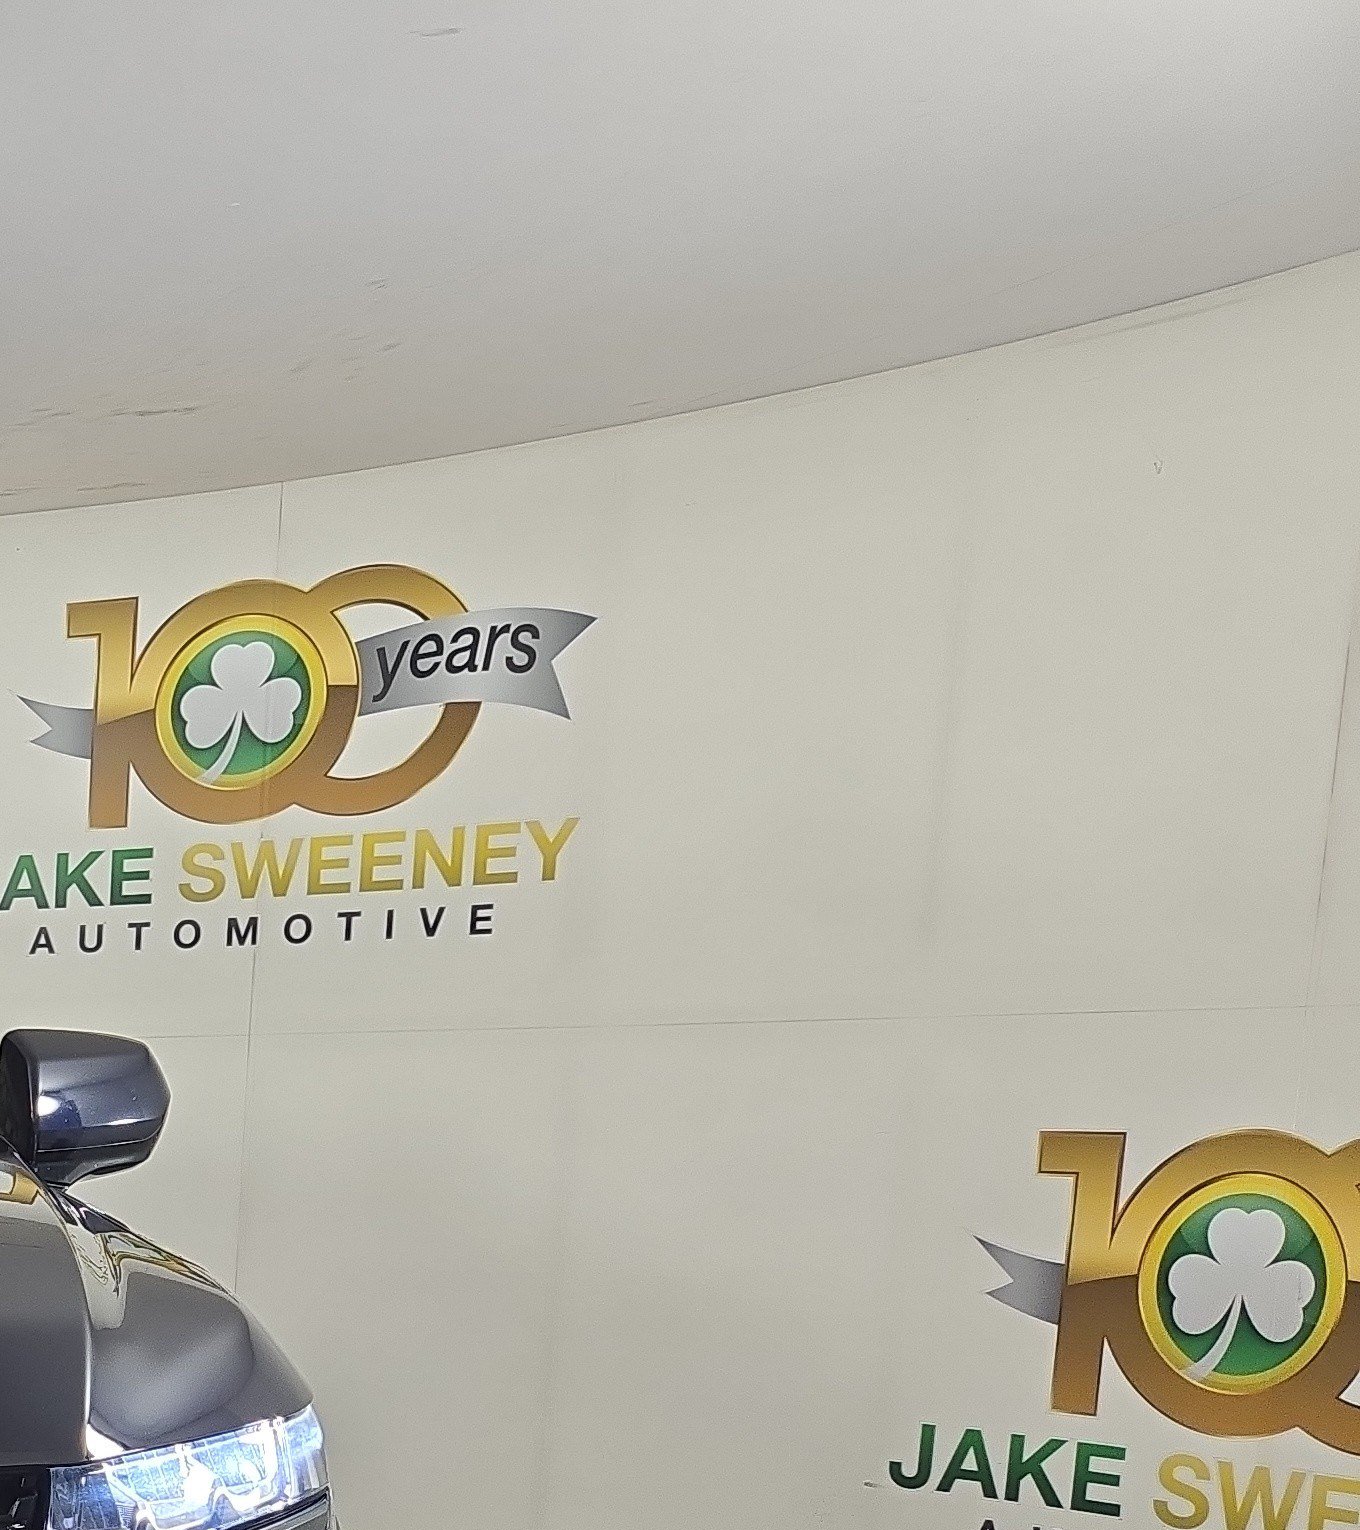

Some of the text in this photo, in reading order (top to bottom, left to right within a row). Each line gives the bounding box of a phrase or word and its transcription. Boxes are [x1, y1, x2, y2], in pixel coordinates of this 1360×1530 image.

[372, 621, 541, 703] years
[178, 816, 580, 902] SWEENEY
[28, 903, 495, 955] AUTOMOTIVE
[1037, 1127, 1360, 1456] 10
[888, 1423, 1127, 1518] JAKE
